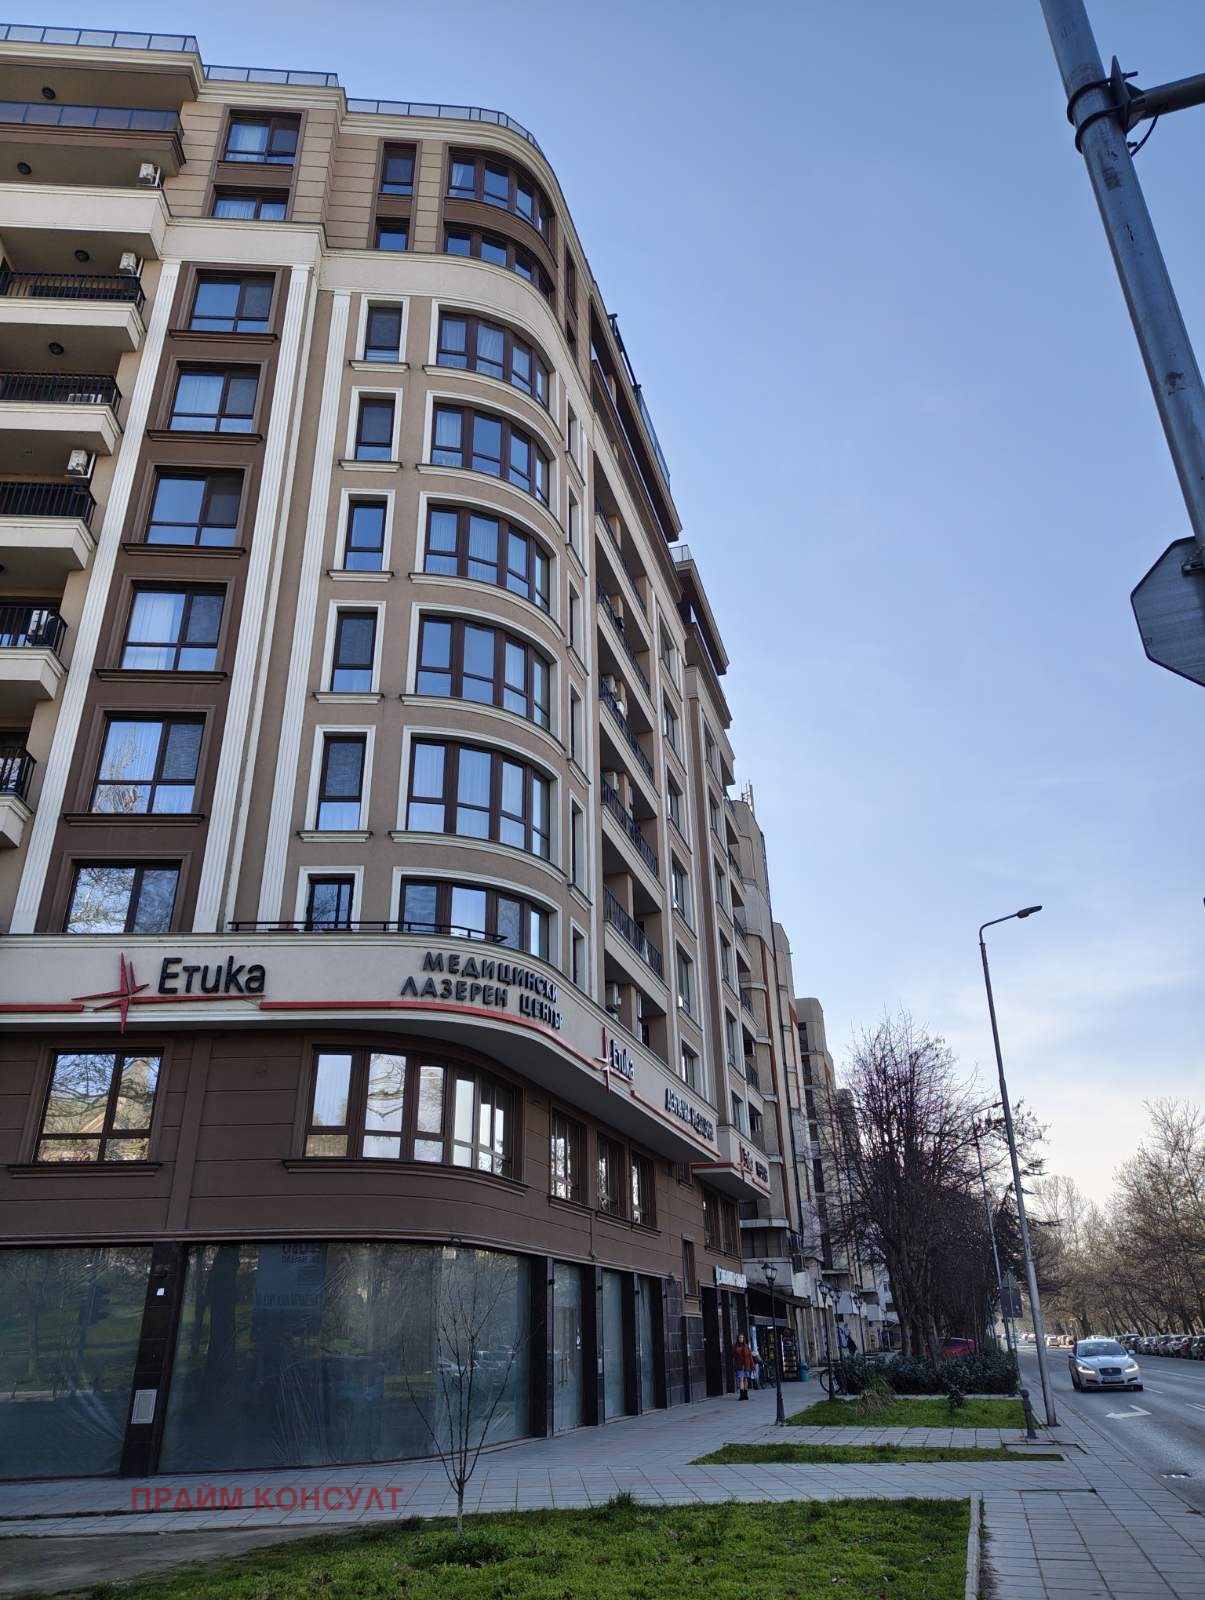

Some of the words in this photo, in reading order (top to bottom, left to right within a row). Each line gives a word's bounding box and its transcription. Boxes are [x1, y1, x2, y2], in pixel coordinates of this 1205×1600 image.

[158, 955, 266, 995] Етика
[400, 976, 508, 1007] ЛАЗЕРЕН
[423, 952, 558, 1003] МЕДИЦИНСКИ
